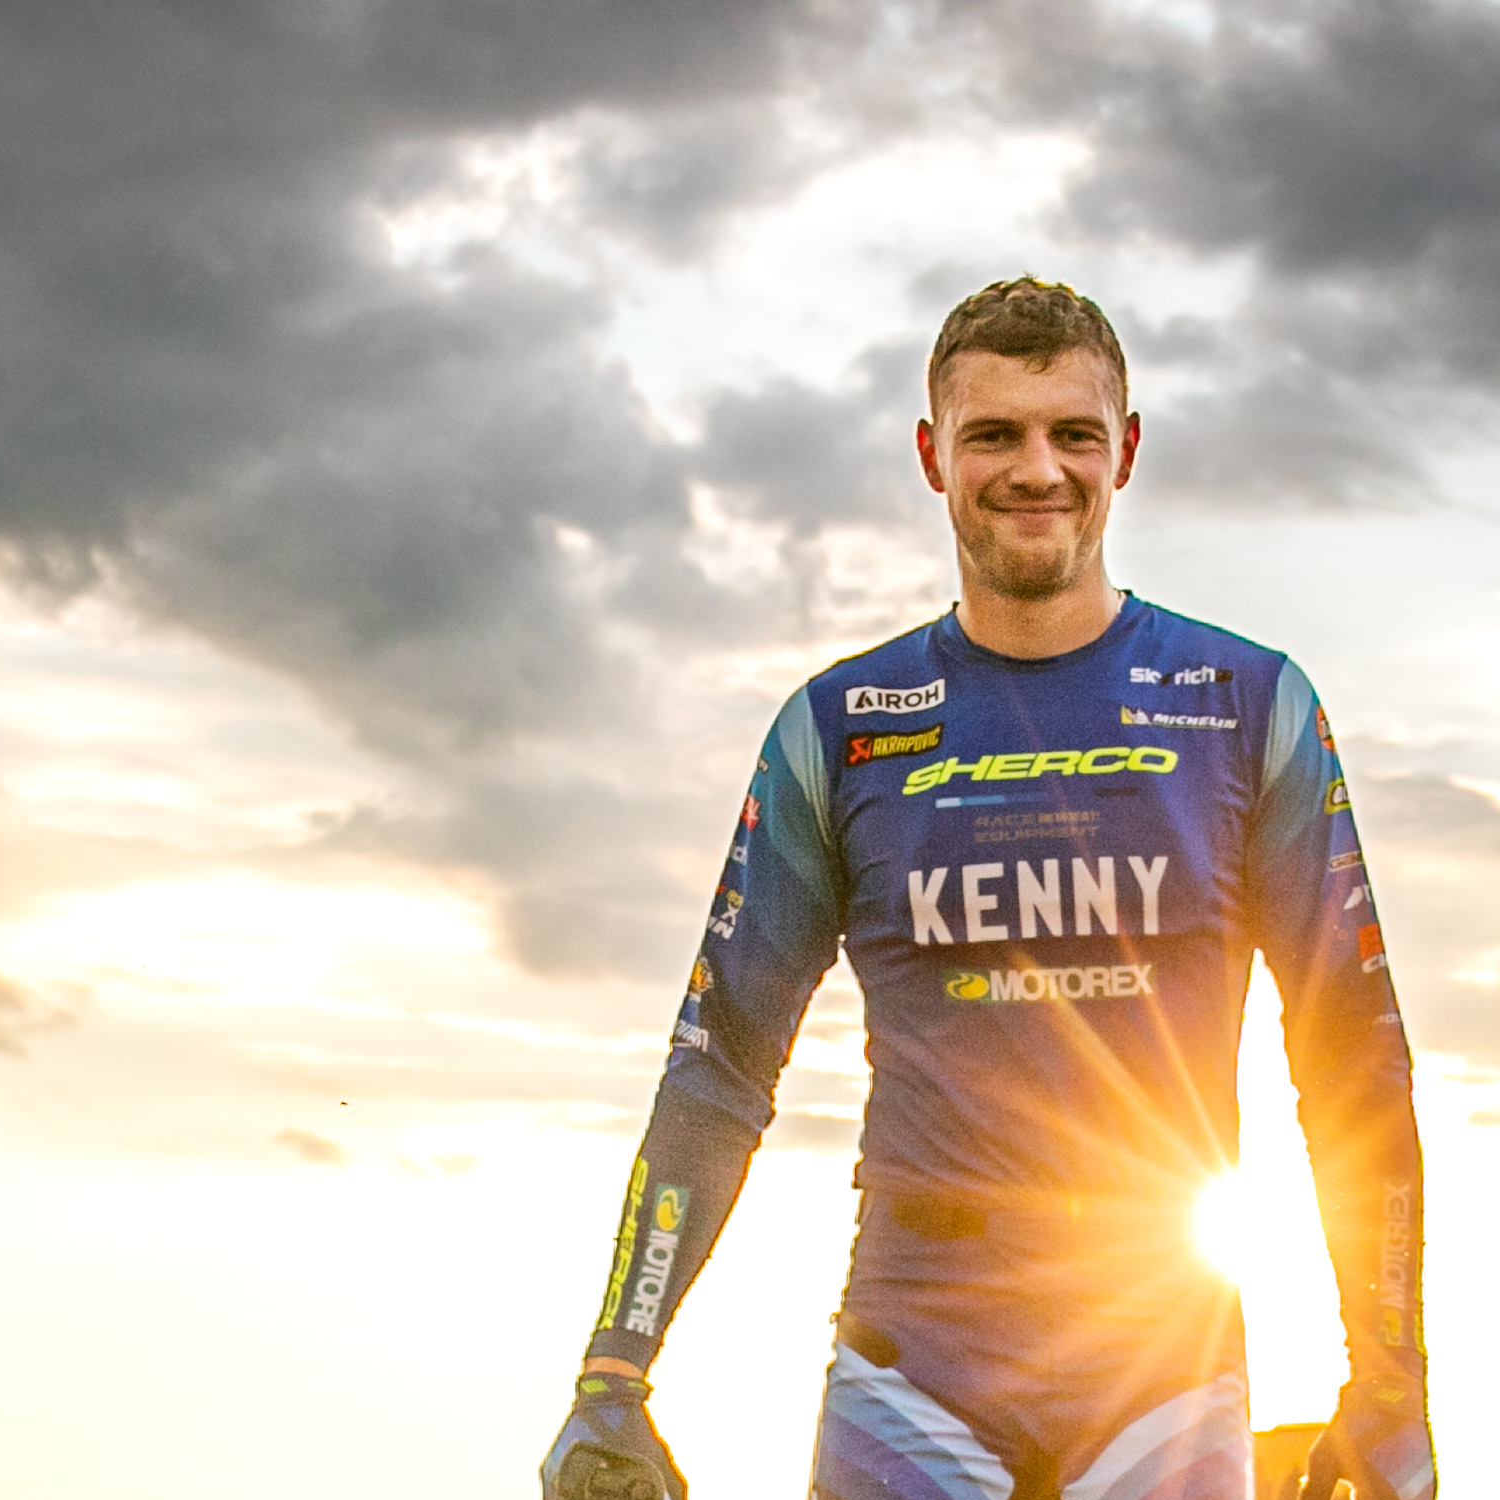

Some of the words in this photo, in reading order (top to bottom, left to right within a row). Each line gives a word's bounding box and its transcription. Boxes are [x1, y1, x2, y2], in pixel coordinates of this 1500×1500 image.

[854, 685, 939, 709] AIROH
[1153, 713, 1237, 729] MICHELIN
[902, 747, 1178, 795] SHERCO
[908, 857, 1169, 945] KENNY
[990, 964, 1154, 1001] MOTOREX
